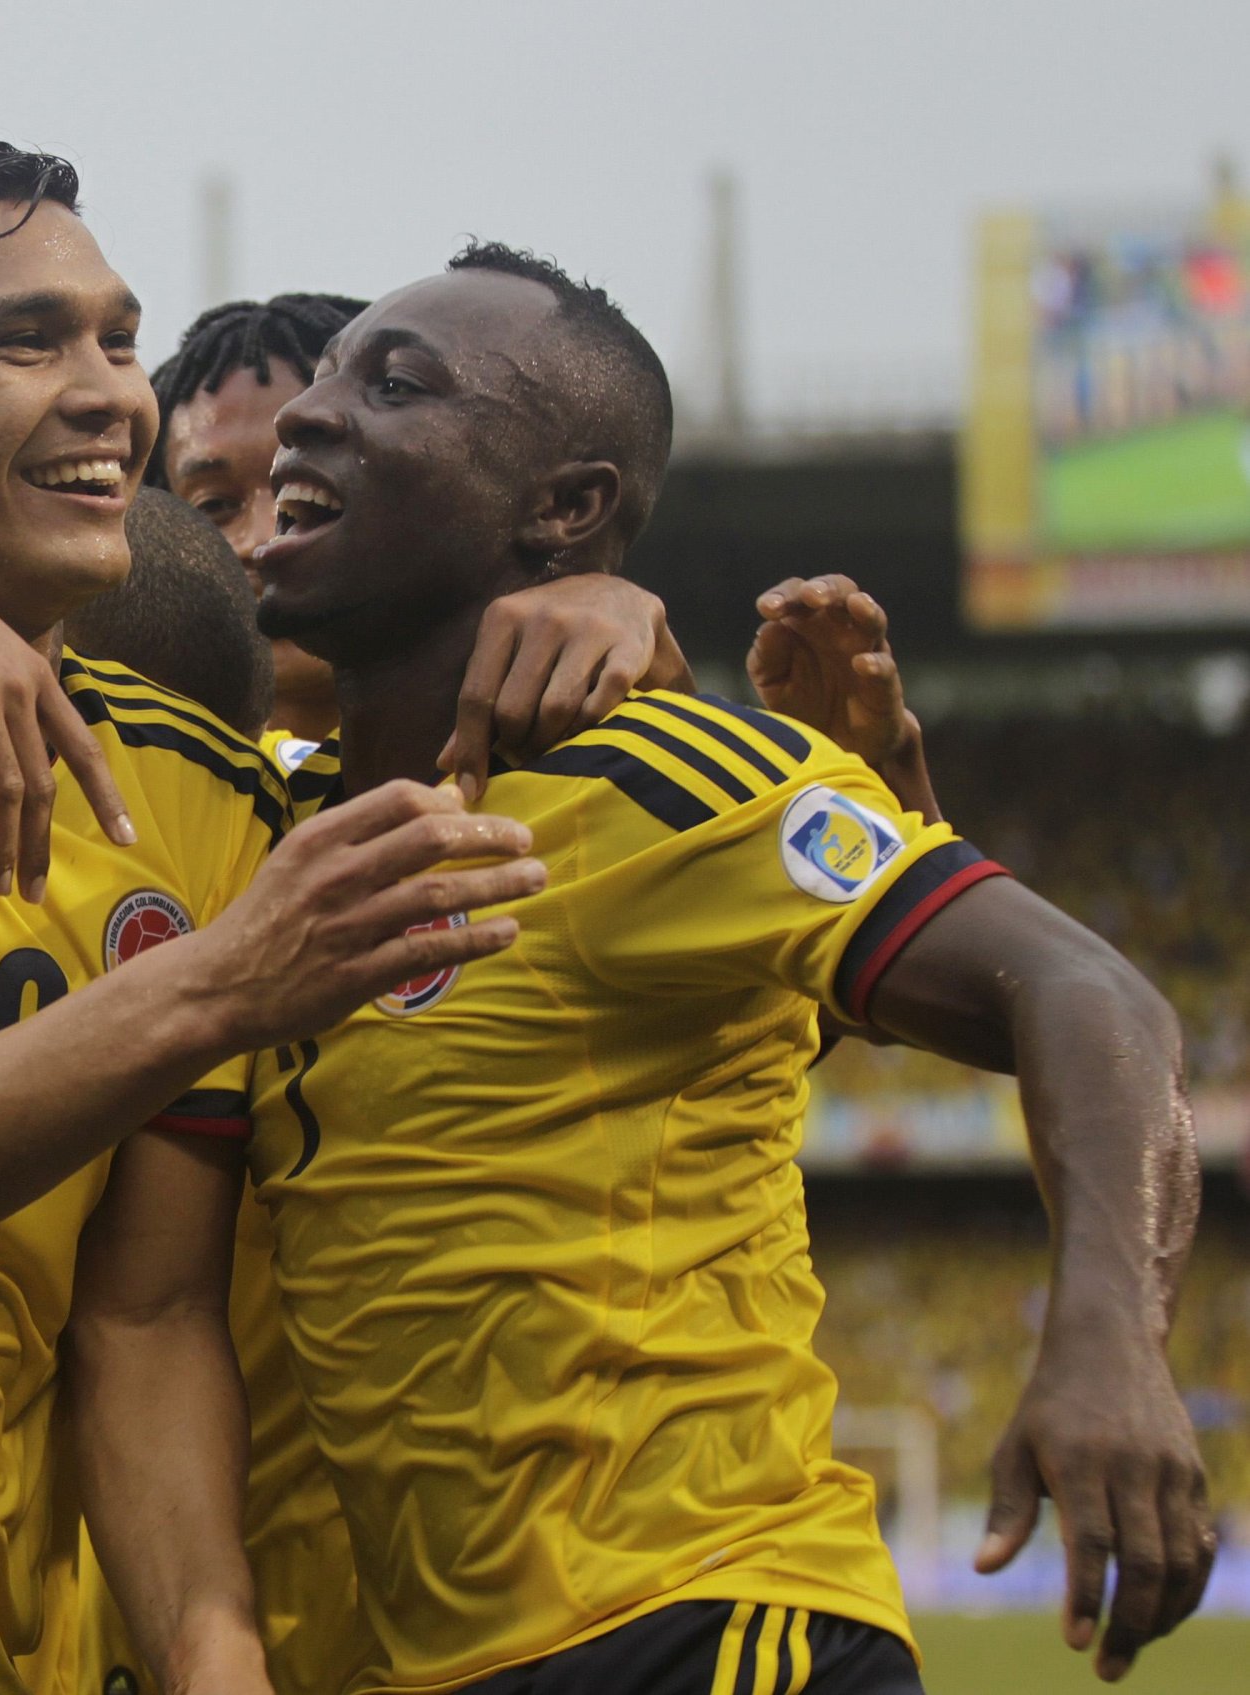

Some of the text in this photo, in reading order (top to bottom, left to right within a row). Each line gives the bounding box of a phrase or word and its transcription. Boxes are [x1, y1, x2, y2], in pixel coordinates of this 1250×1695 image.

[110, 896, 187, 949] FEDERACION COLOMBIANA DE
